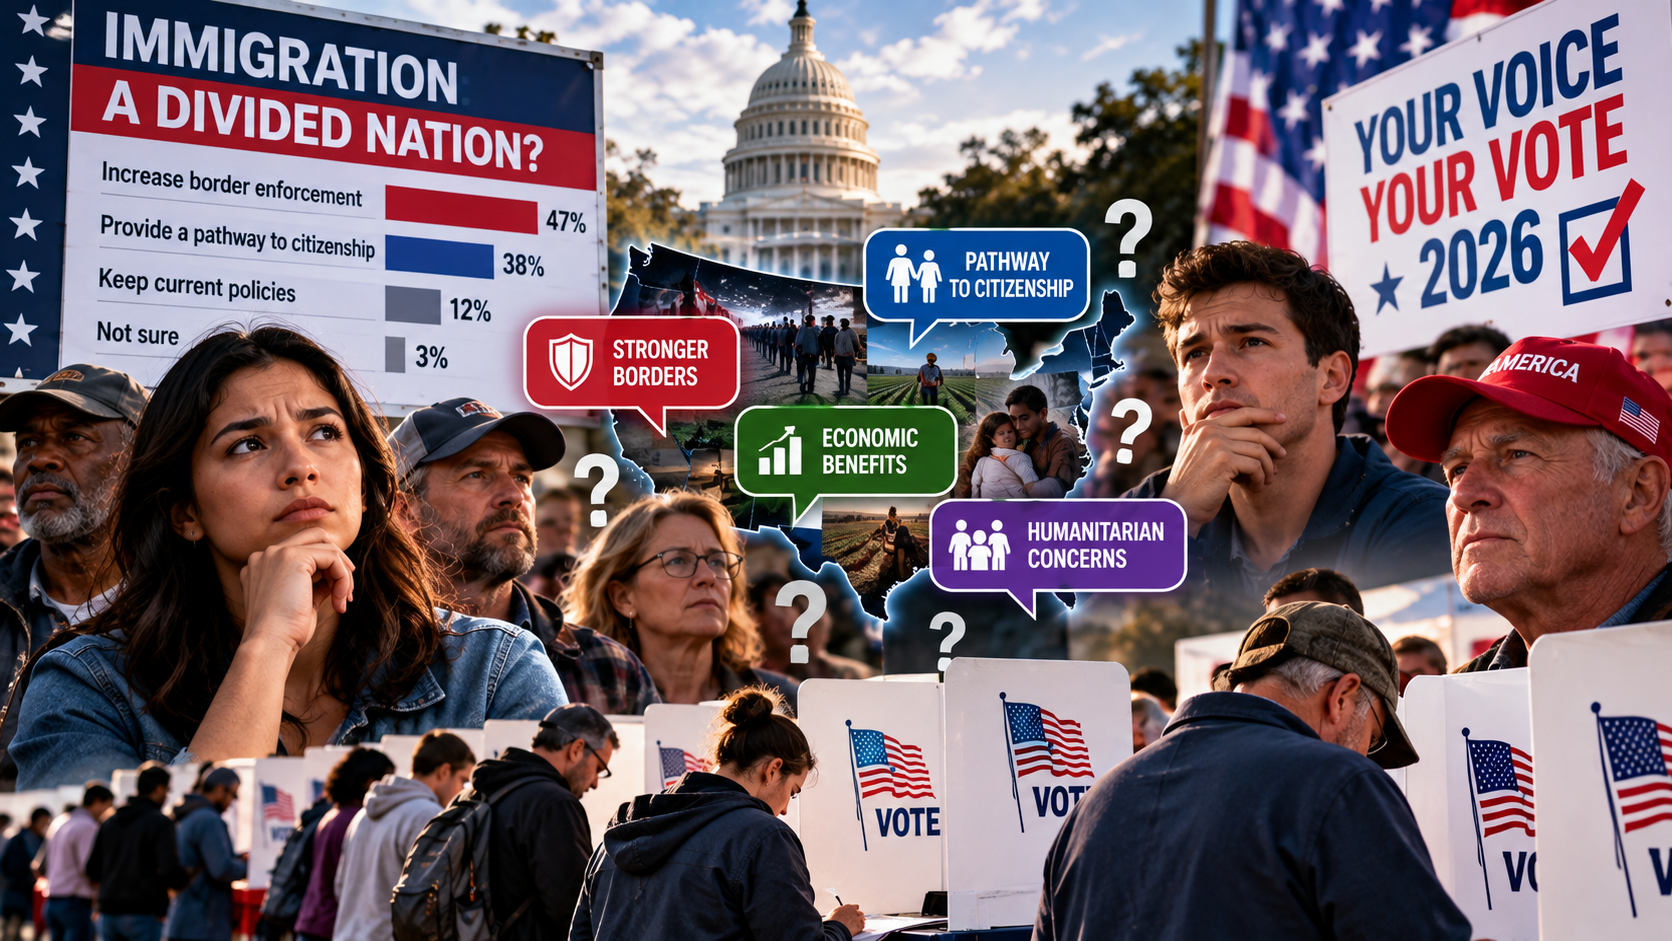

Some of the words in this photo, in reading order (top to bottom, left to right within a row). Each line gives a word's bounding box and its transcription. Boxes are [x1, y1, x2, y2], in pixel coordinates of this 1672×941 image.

[104, 10, 459, 106] IMMIGRATION
[1354, 82, 1464, 175] YOUR
[1473, 12, 1624, 130] VOICE
[101, 79, 141, 126] A
[156, 84, 353, 149] DIVIDED
[366, 111, 545, 173] NATION?
[101, 161, 184, 188] Increase
[189, 170, 251, 195] border
[255, 180, 363, 208] enforcement
[1360, 150, 1478, 244] YOUR
[1488, 93, 1628, 203] VOTE
[100, 214, 173, 240] Provide
[177, 226, 189, 242] a
[193, 225, 267, 253] pathway
[271, 232, 288, 251] to
[291, 233, 376, 263] citizenship
[546, 209, 587, 234] 47%
[502, 252, 545, 277] 38%
[1418, 208, 1544, 309] 2026
[98, 267, 149, 295] Keep
[154, 276, 223, 297] current
[228, 279, 297, 303] policies
[449, 297, 492, 323] 12%
[97, 320, 133, 343] Not
[137, 328, 180, 346] sure
[415, 344, 449, 369] 3%
[1484, 353, 1580, 384] AMERICA
[1032, 785, 1091, 818] VOT
[875, 806, 941, 838] VOTE
